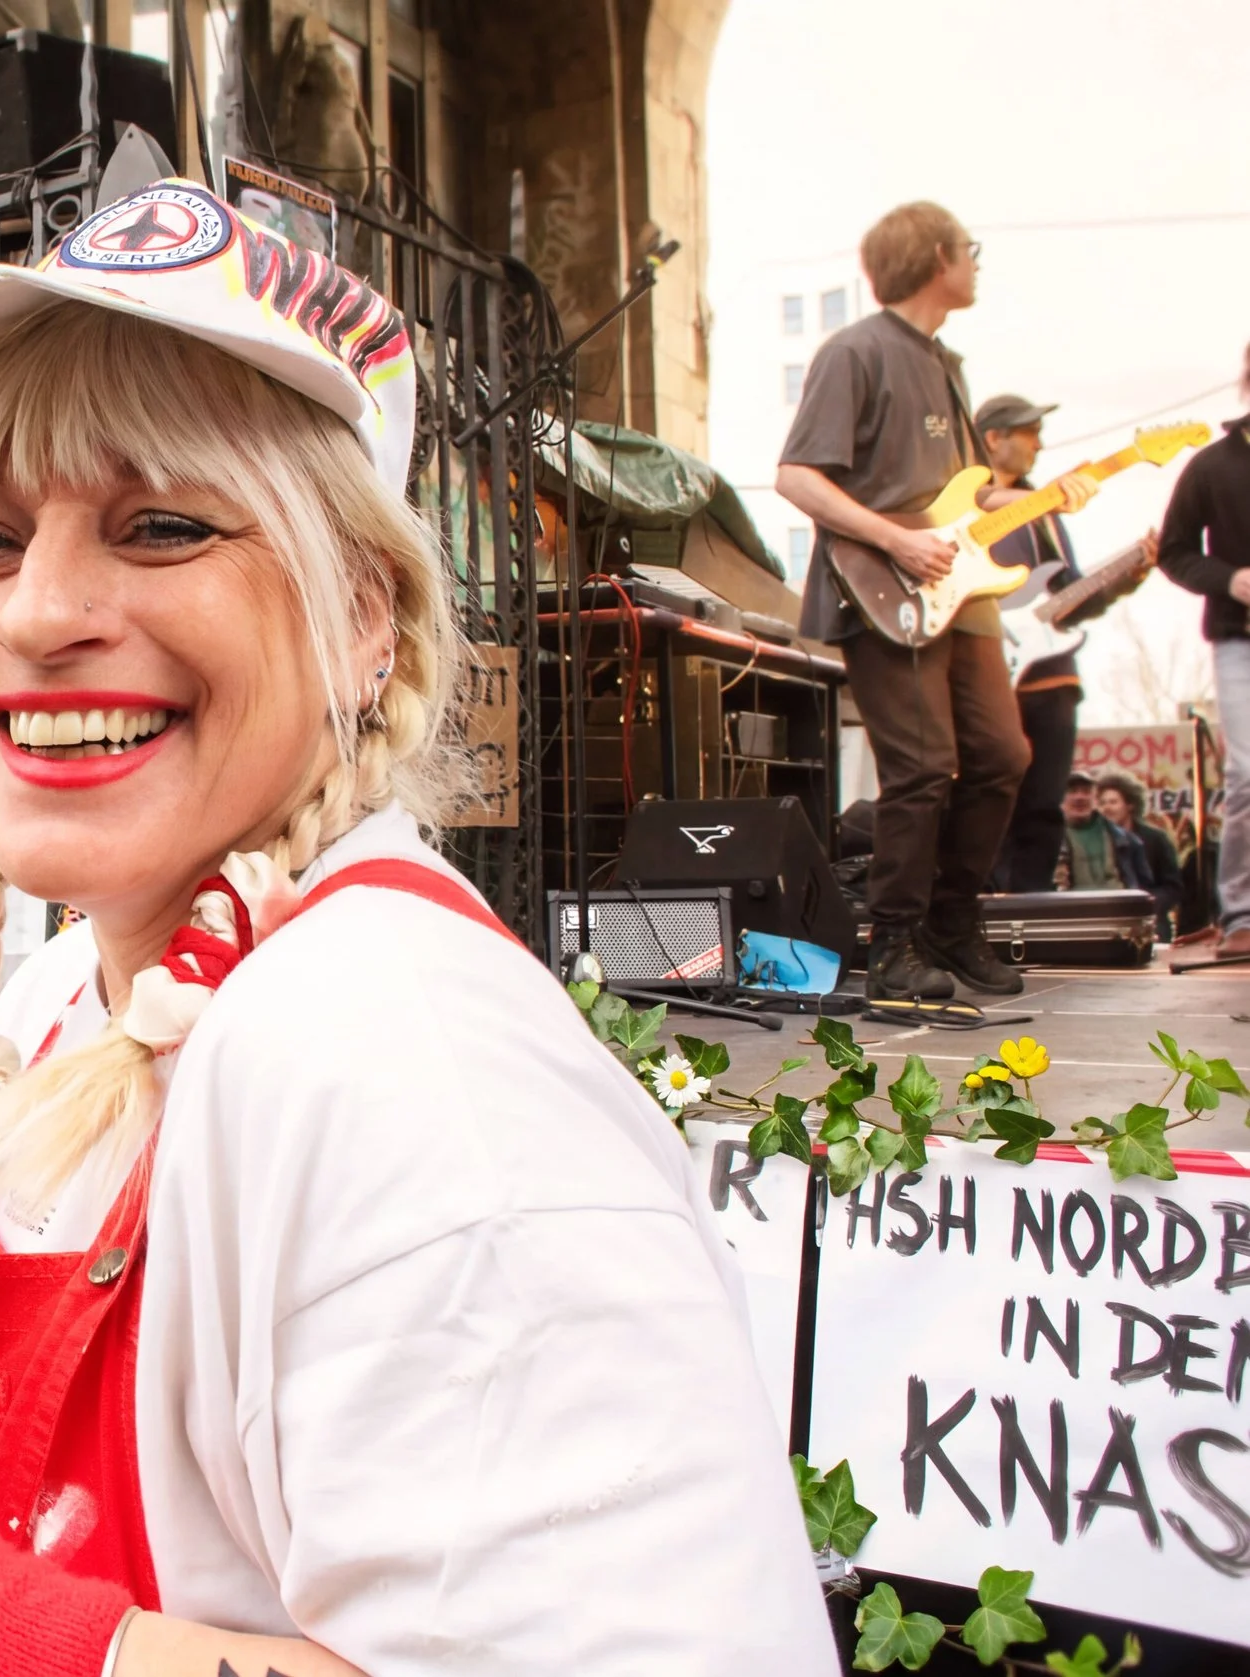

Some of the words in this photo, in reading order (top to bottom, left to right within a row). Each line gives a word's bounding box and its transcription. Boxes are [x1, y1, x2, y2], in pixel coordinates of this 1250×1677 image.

[845, 1171, 977, 1258] HSH
[1001, 1295, 1080, 1380] IN
[899, 1373, 1250, 1580] KNAS
